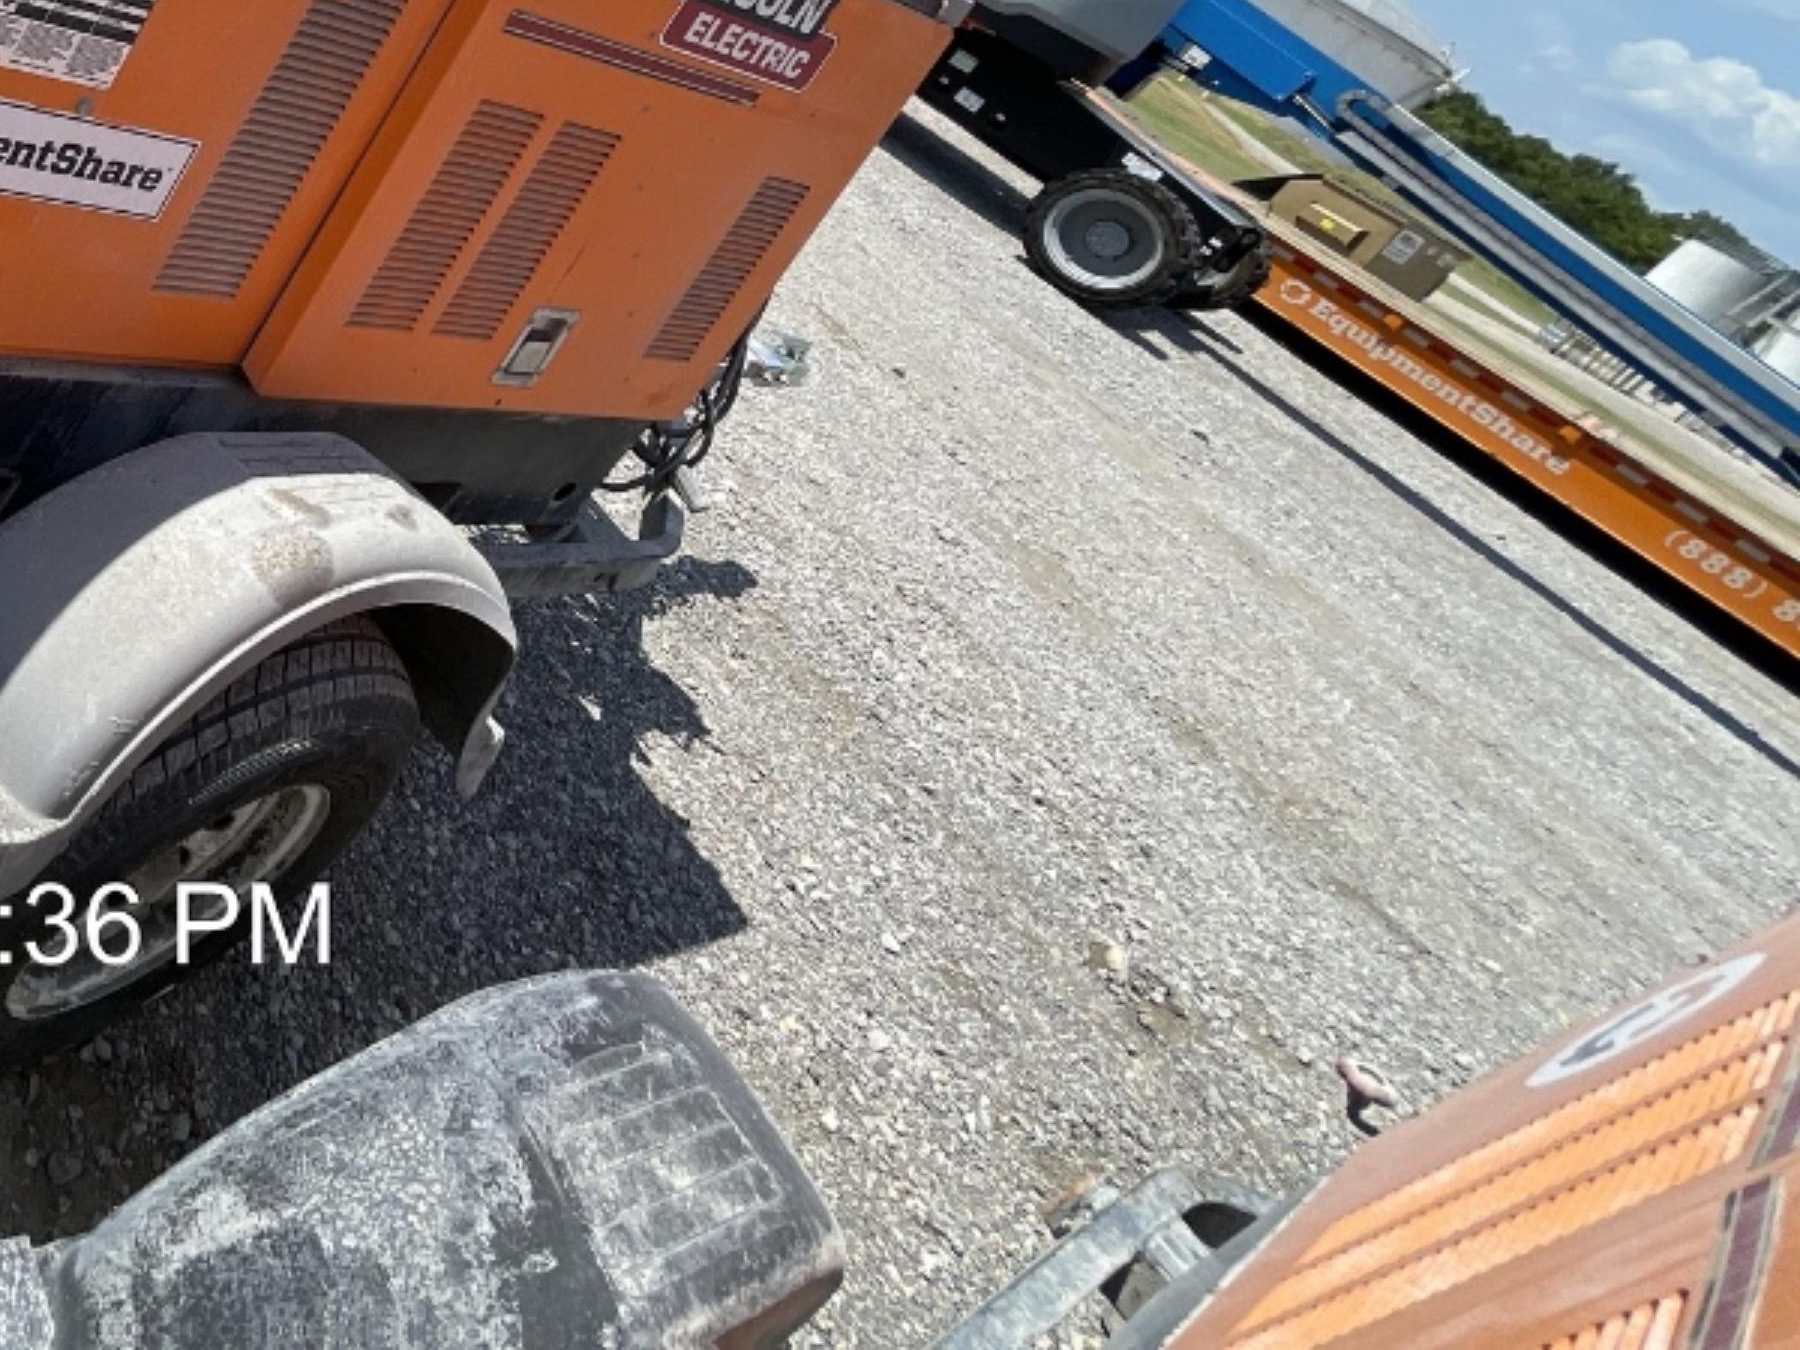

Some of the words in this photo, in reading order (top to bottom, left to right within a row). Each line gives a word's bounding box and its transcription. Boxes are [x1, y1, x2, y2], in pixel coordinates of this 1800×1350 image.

[683, 11, 811, 78] ELECTRIC
[1307, 297, 1571, 476] EquipmentShare
[1664, 529, 1768, 598] (888)
